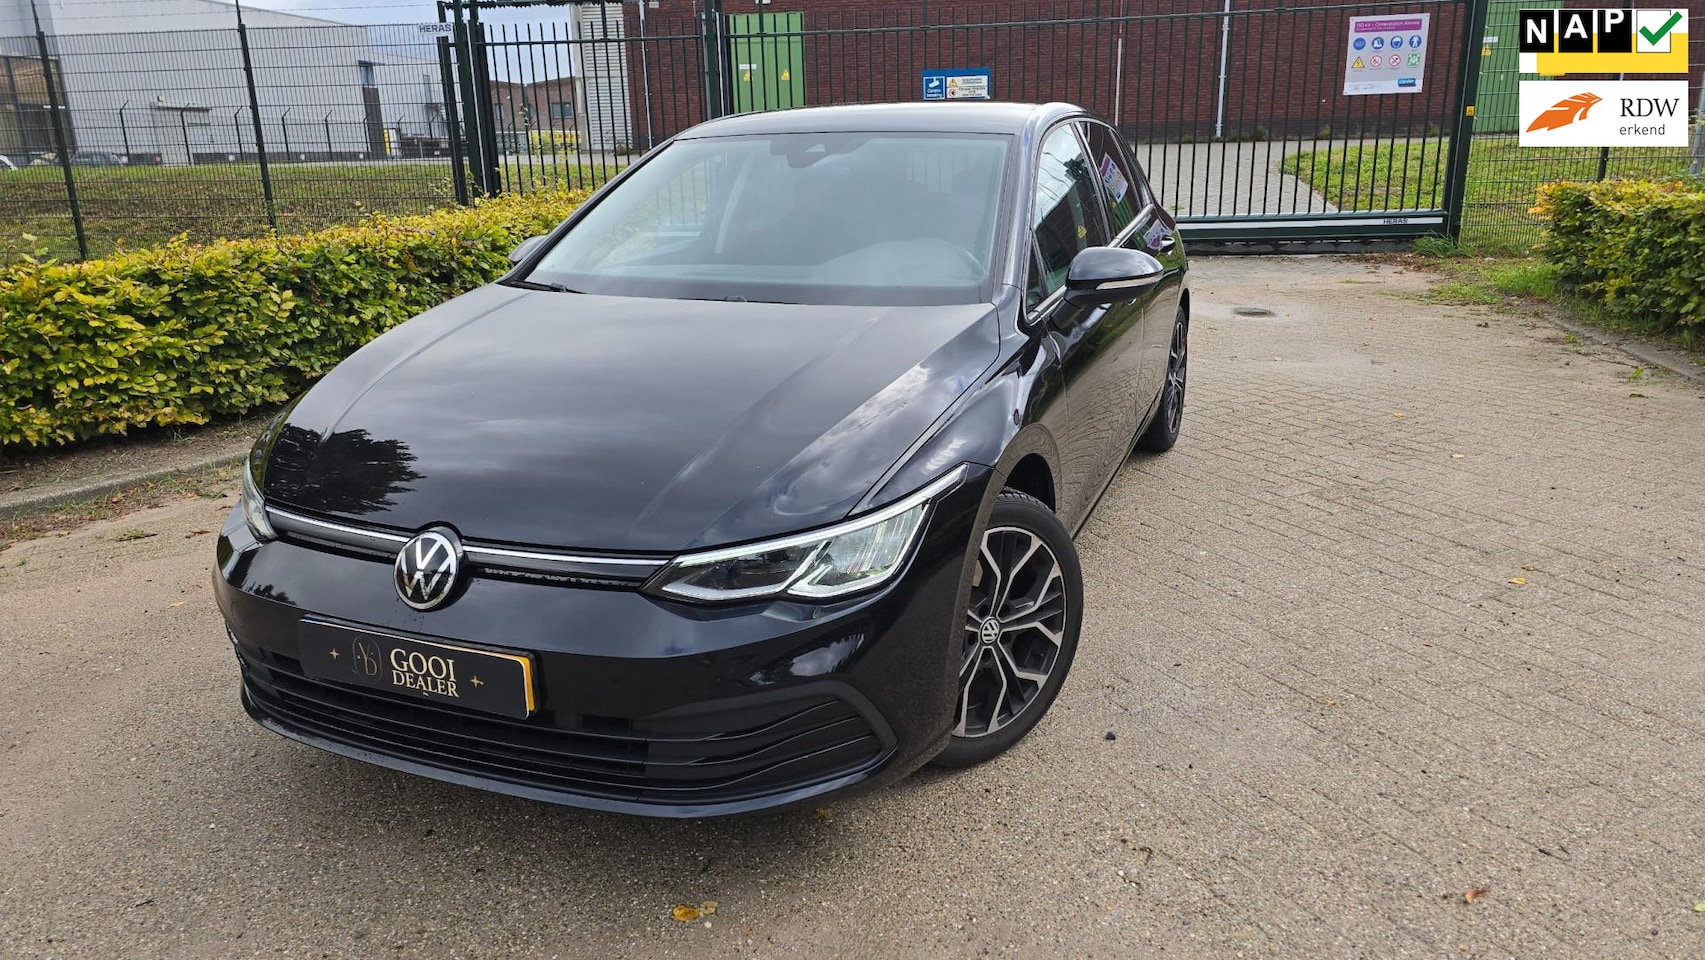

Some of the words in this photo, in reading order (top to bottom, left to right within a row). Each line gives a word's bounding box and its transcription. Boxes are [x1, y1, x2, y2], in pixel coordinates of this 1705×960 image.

[419, 24, 452, 33] HERAS
[390, 648, 456, 682] GOOI
[392, 670, 460, 698] DEALER
